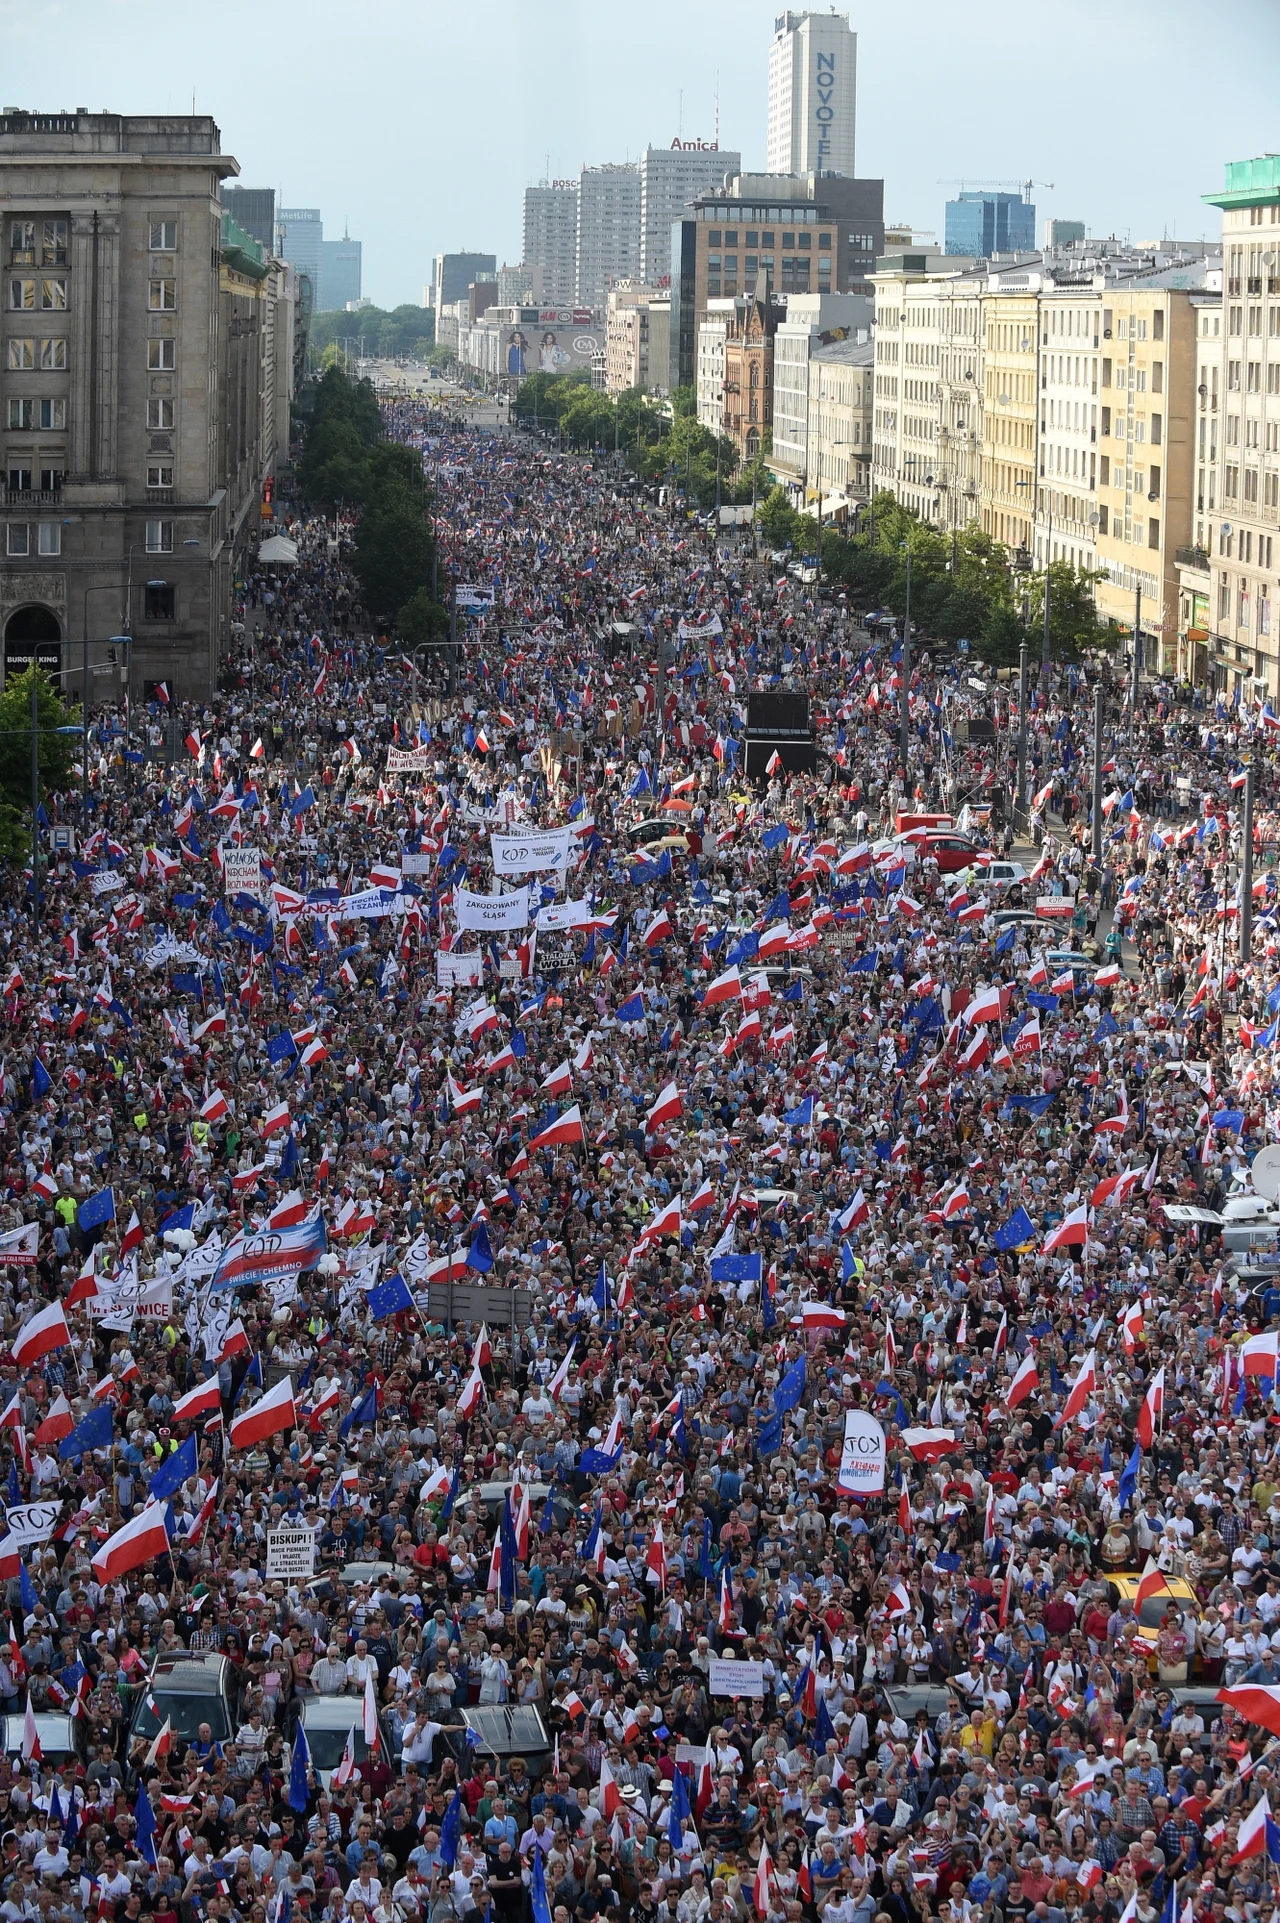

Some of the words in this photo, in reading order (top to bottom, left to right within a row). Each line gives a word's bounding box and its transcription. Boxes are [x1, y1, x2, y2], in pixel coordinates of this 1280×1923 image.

[670, 137, 719, 151] Amica
[280, 211, 313, 219] MetLife
[577, 339, 593, 349] C&A
[961, 640, 968, 648] P
[224, 851, 259, 865] WOLNOŚĆ
[502, 848, 529, 861] KOD
[227, 880, 259, 889] ROZUMIEM
[351, 895, 380, 904] KOCHA
[465, 899, 520, 910] ZAKODOWANY
[482, 911, 506, 920] ŚLĄSK
[541, 951, 576, 960] STALOWA
[541, 959, 575, 969] WOLA
[243, 1234, 282, 1259] KOD
[18, 1256, 34, 1264] POLSKĘ
[228, 1270, 257, 1285] ŚWIECIE
[262, 1261, 303, 1276] CHEŁMNO
[270, 1534, 307, 1545] BISKUPI
[186, 1616, 193, 1625] P
